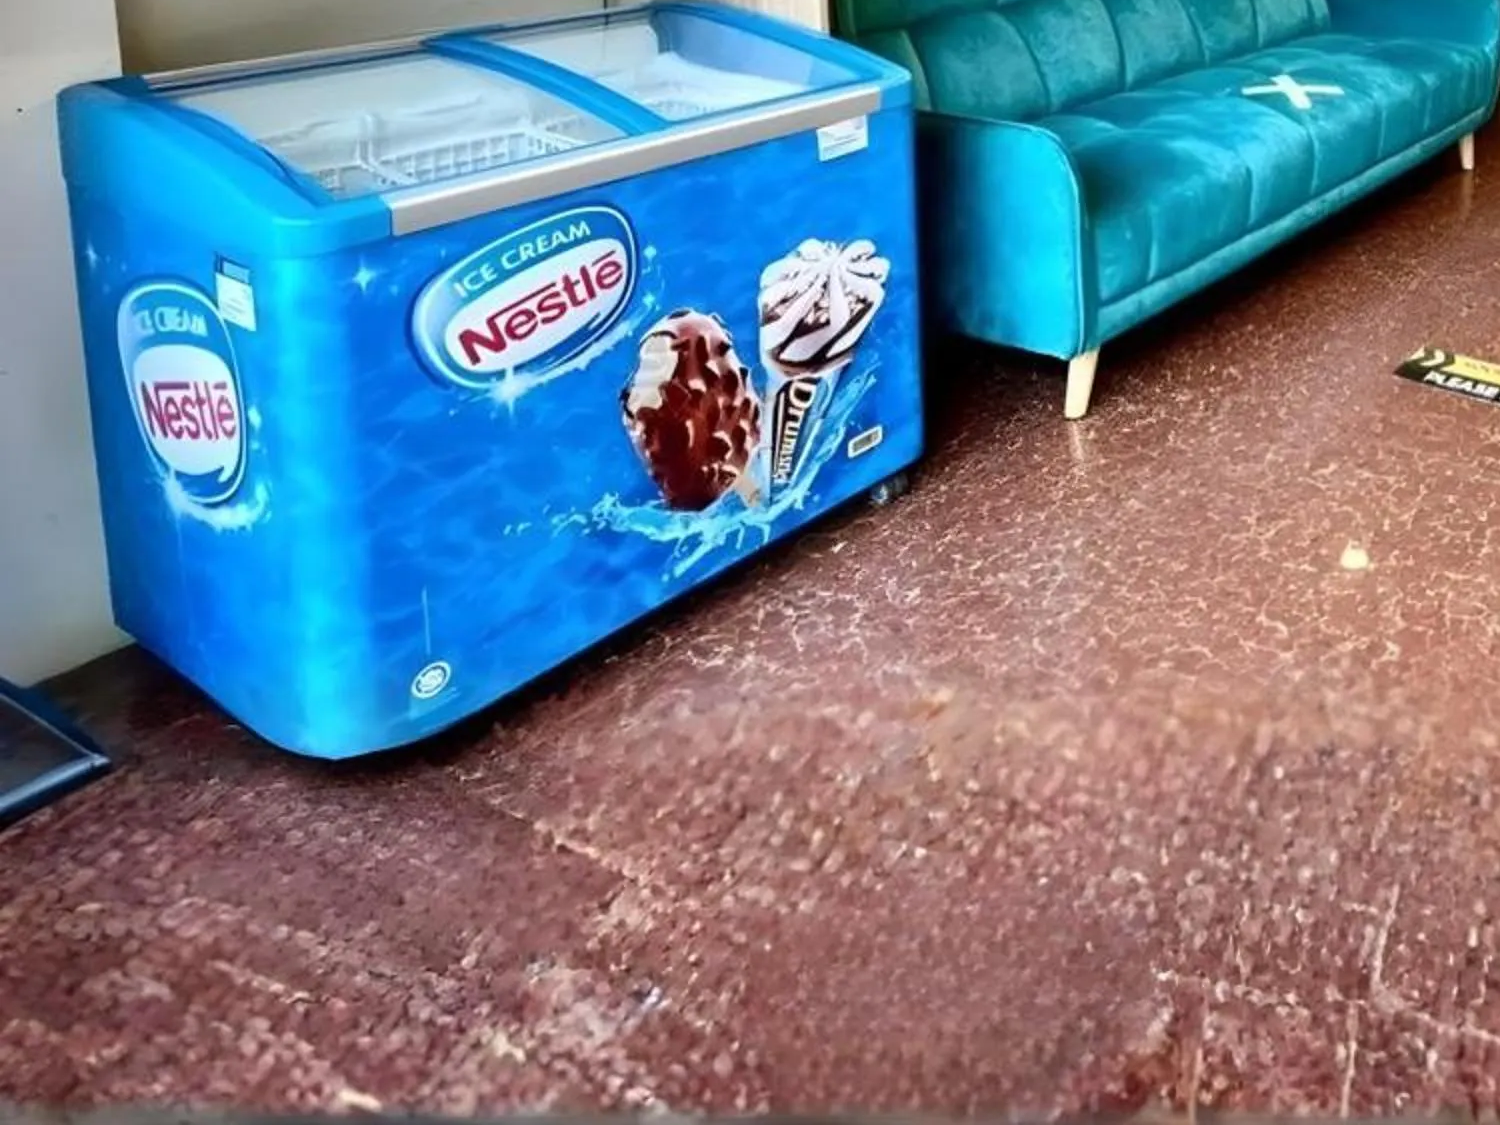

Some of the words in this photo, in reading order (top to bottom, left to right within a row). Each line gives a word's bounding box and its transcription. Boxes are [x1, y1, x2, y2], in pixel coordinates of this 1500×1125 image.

[453, 263, 498, 299] ICE
[501, 220, 591, 271] CREAM
[1424, 370, 1500, 398] PLEASE
